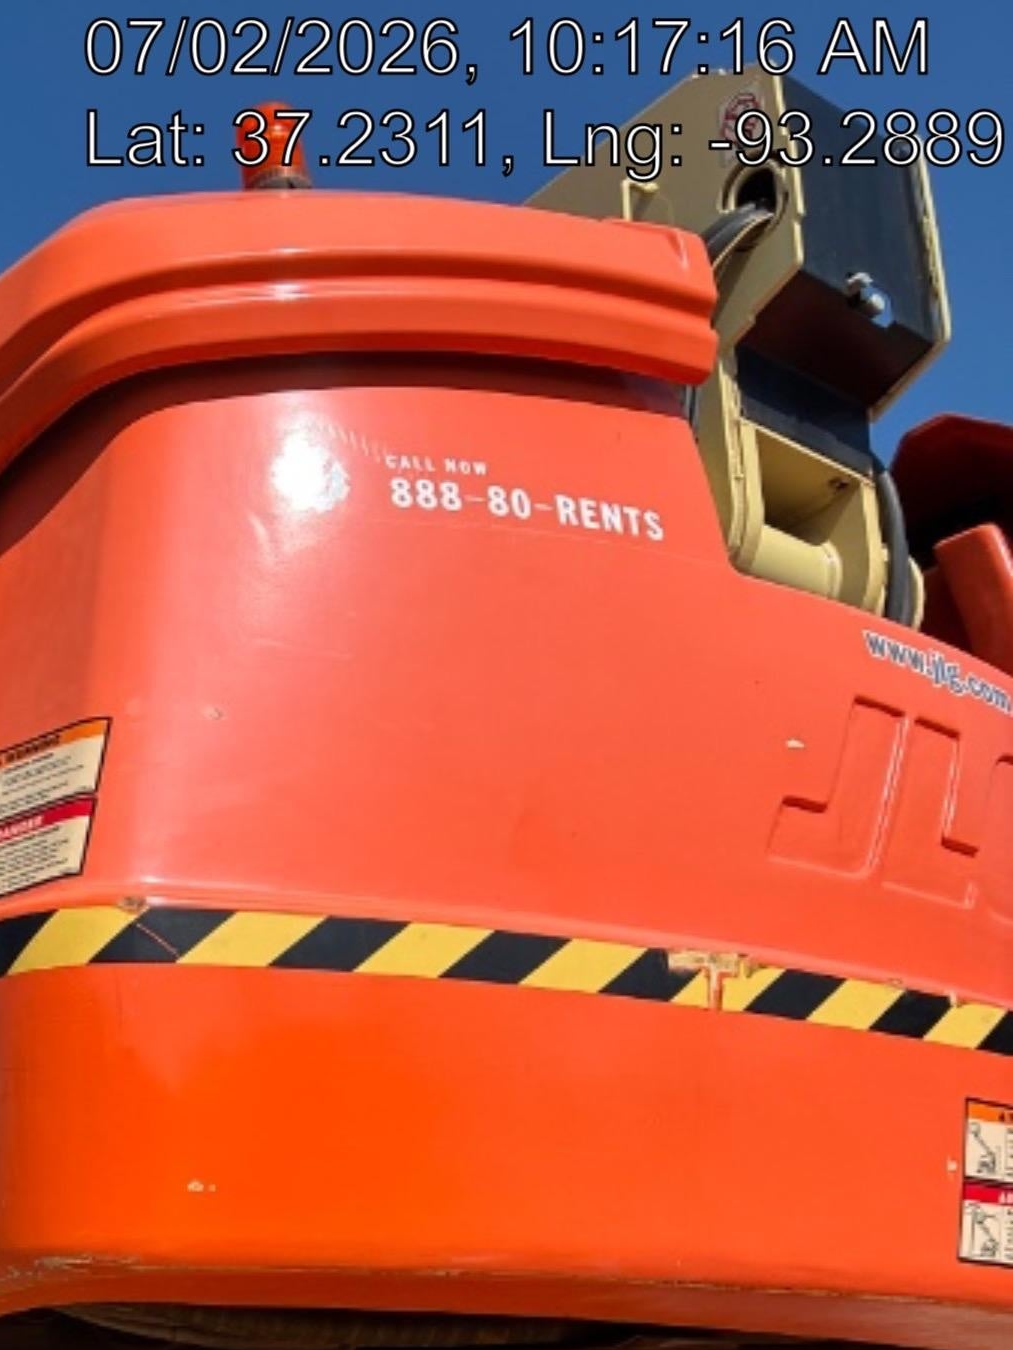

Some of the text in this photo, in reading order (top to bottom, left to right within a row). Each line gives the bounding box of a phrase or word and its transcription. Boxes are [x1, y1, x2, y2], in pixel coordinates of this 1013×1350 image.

[385, 455, 488, 476] CALL NOW
[390, 477, 665, 541] 888-80-RENTS
[861, 629, 1013, 717] www.jlg.com
